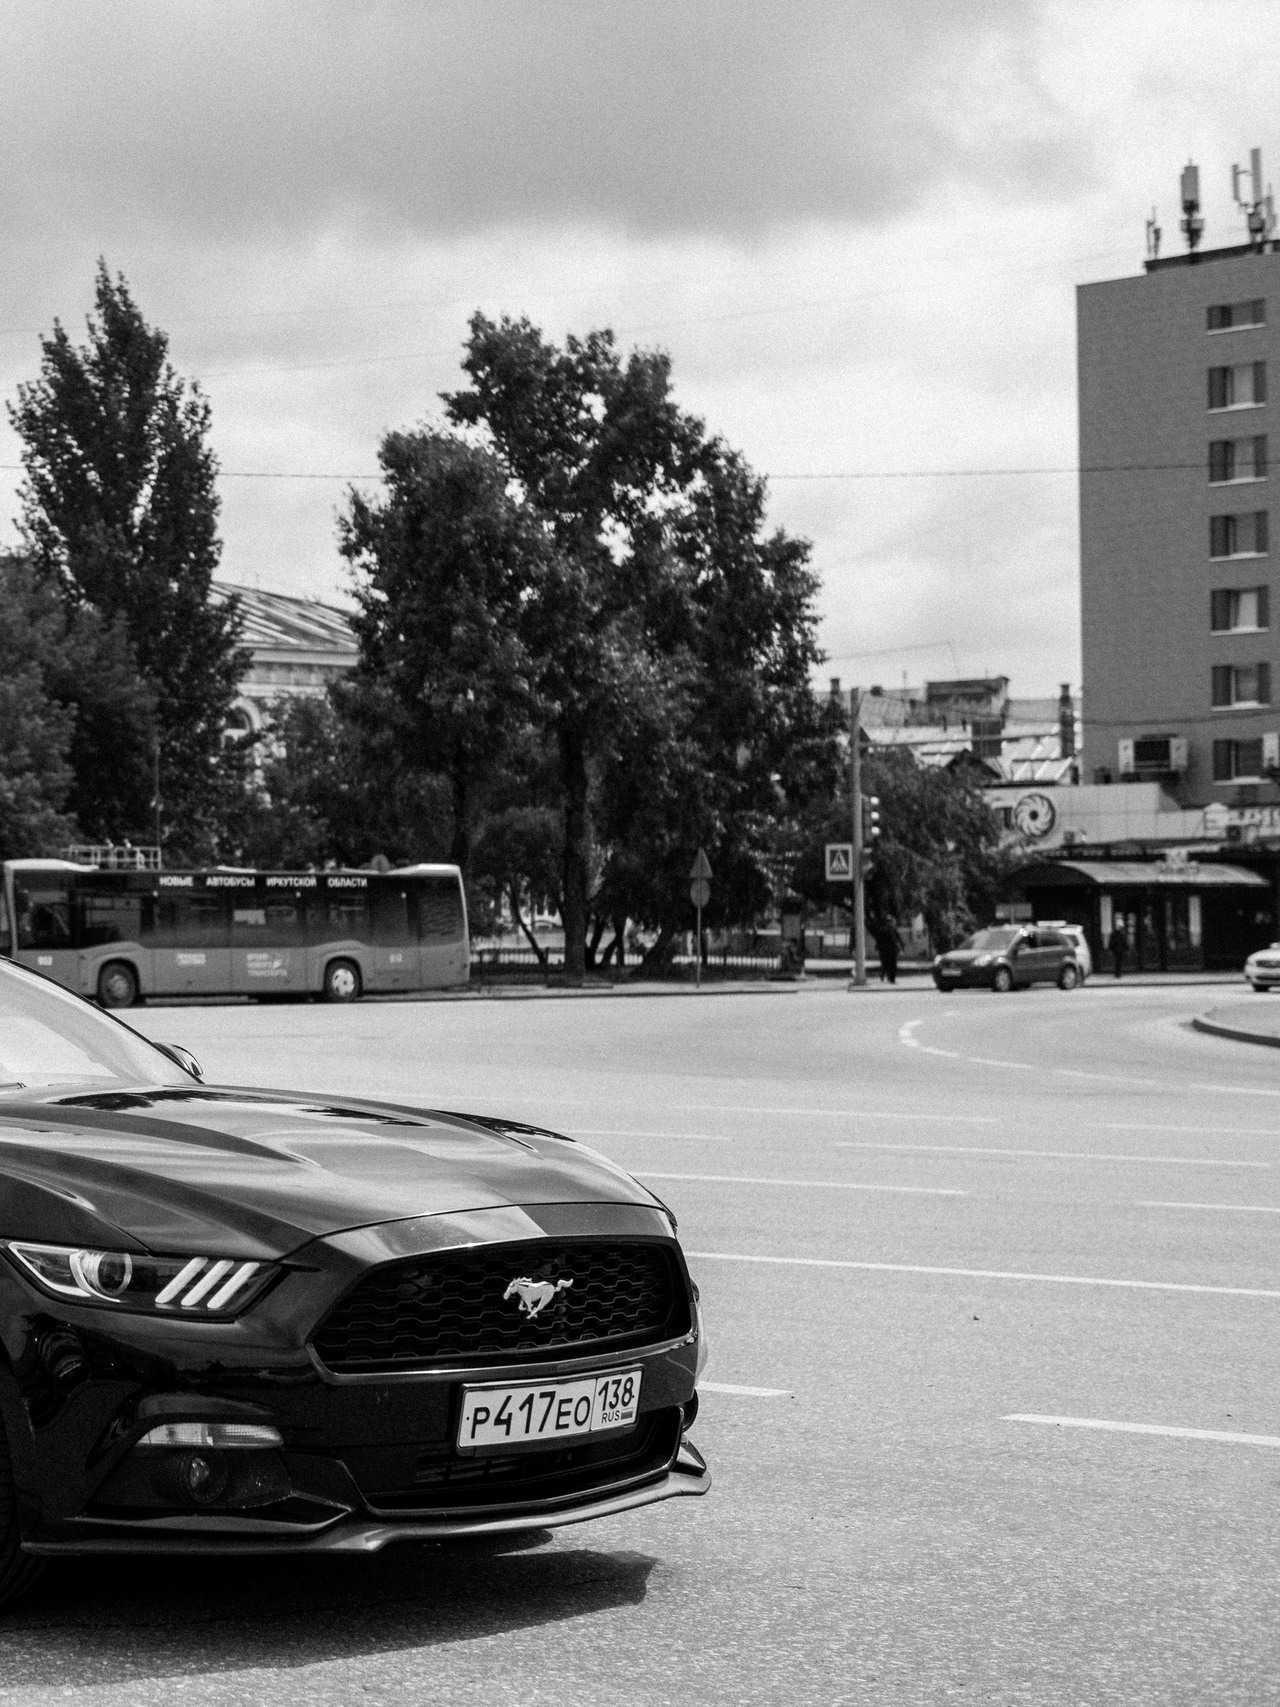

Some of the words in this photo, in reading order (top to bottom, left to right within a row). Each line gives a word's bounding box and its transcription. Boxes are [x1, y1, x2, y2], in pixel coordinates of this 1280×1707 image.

[159, 876, 193, 887] НОВЫЕ
[206, 876, 255, 887] АВТОБУСЫ
[266, 877, 317, 887] ИРКУТСКОЙ
[327, 877, 367, 887] ОБЛАСТИ
[598, 1376, 634, 1411] 138
[601, 1411, 620, 1424] RUS
